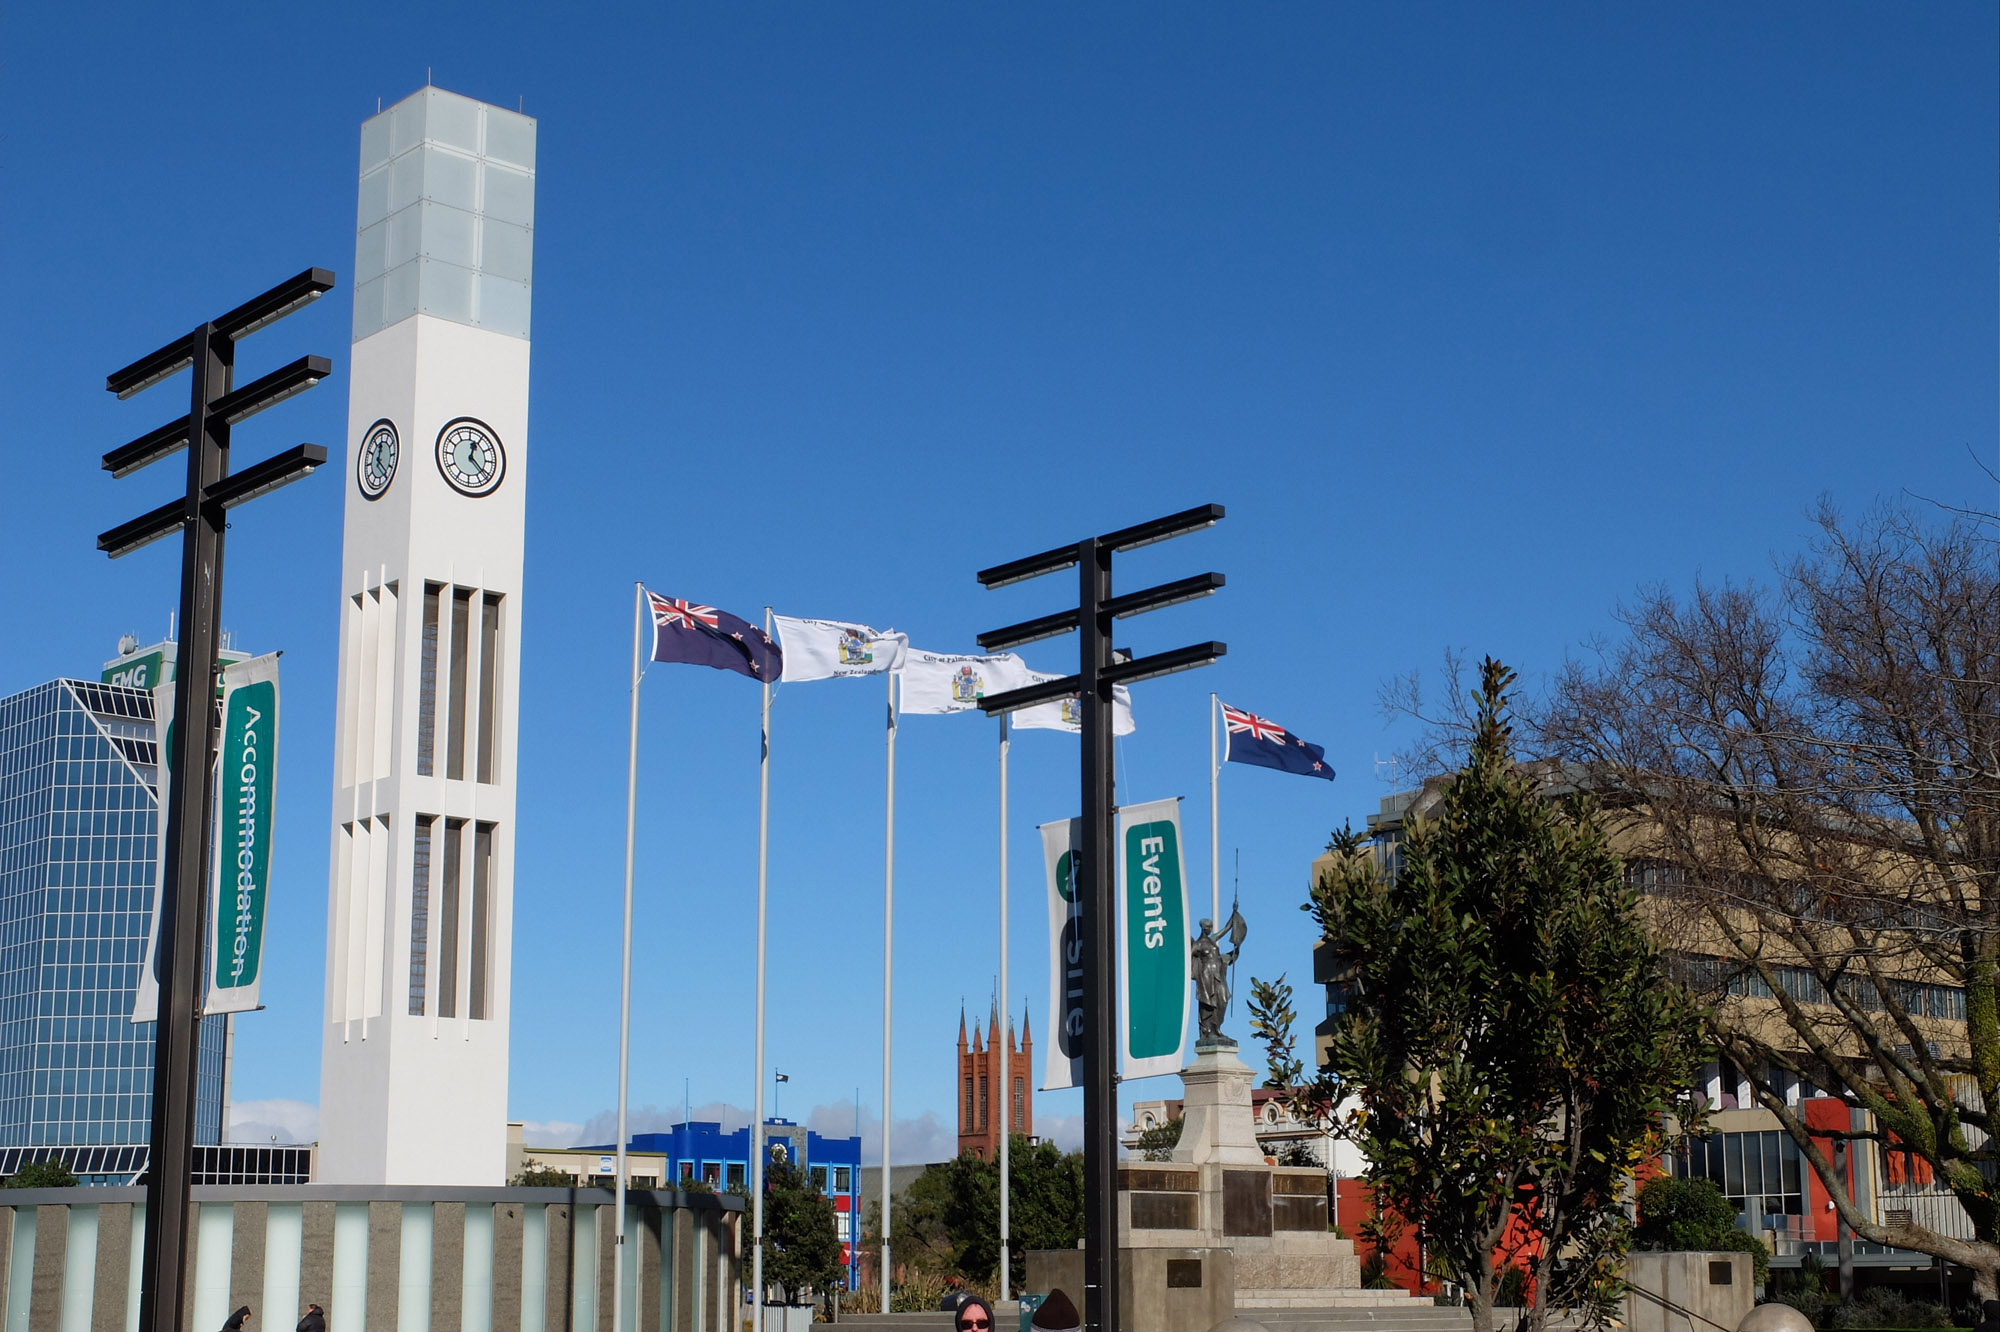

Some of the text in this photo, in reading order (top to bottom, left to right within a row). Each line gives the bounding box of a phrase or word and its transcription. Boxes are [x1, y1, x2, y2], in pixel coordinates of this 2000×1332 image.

[923, 654, 936, 663] City
[230, 705, 261, 977] Accommodation
[1140, 836, 1168, 949] Events
